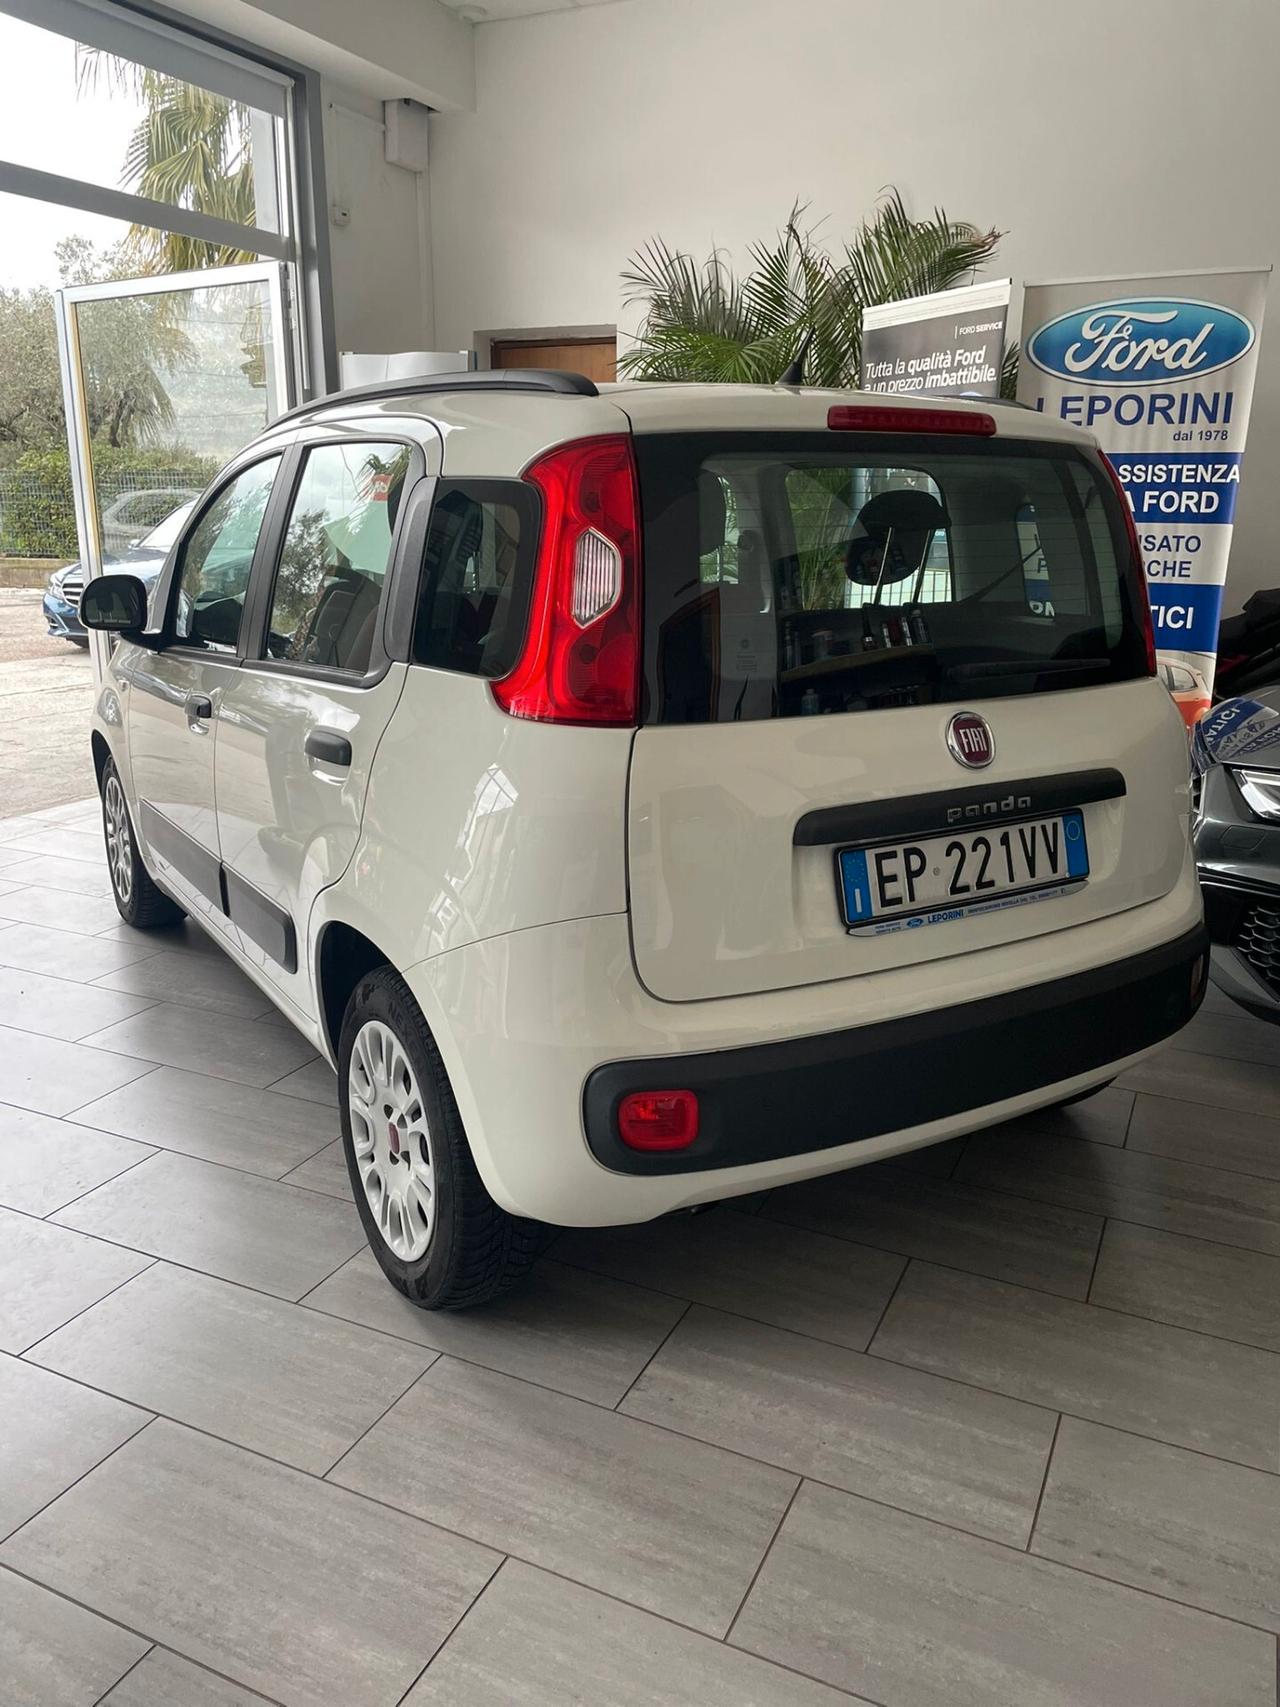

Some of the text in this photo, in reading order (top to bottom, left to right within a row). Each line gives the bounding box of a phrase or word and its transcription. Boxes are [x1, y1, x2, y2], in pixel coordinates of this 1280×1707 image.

[959, 321, 1003, 335] FORD SERVICE
[1064, 310, 1215, 372] Ford
[866, 345, 987, 378] Tutta la qualità Ford
[888, 377, 923, 392] prezzo
[925, 364, 997, 388] imbattibile.
[1173, 430, 1228, 441] dal 1978
[1142, 490, 1219, 514] FORD
[1138, 535, 1202, 553] SATO
[1144, 560, 1192, 578] CHE
[959, 727, 988, 753] FIAT
[947, 795, 1031, 822] panda
[874, 847, 927, 909] EP
[945, 821, 1059, 896] 221VV
[927, 908, 964, 924] LEPORINI
